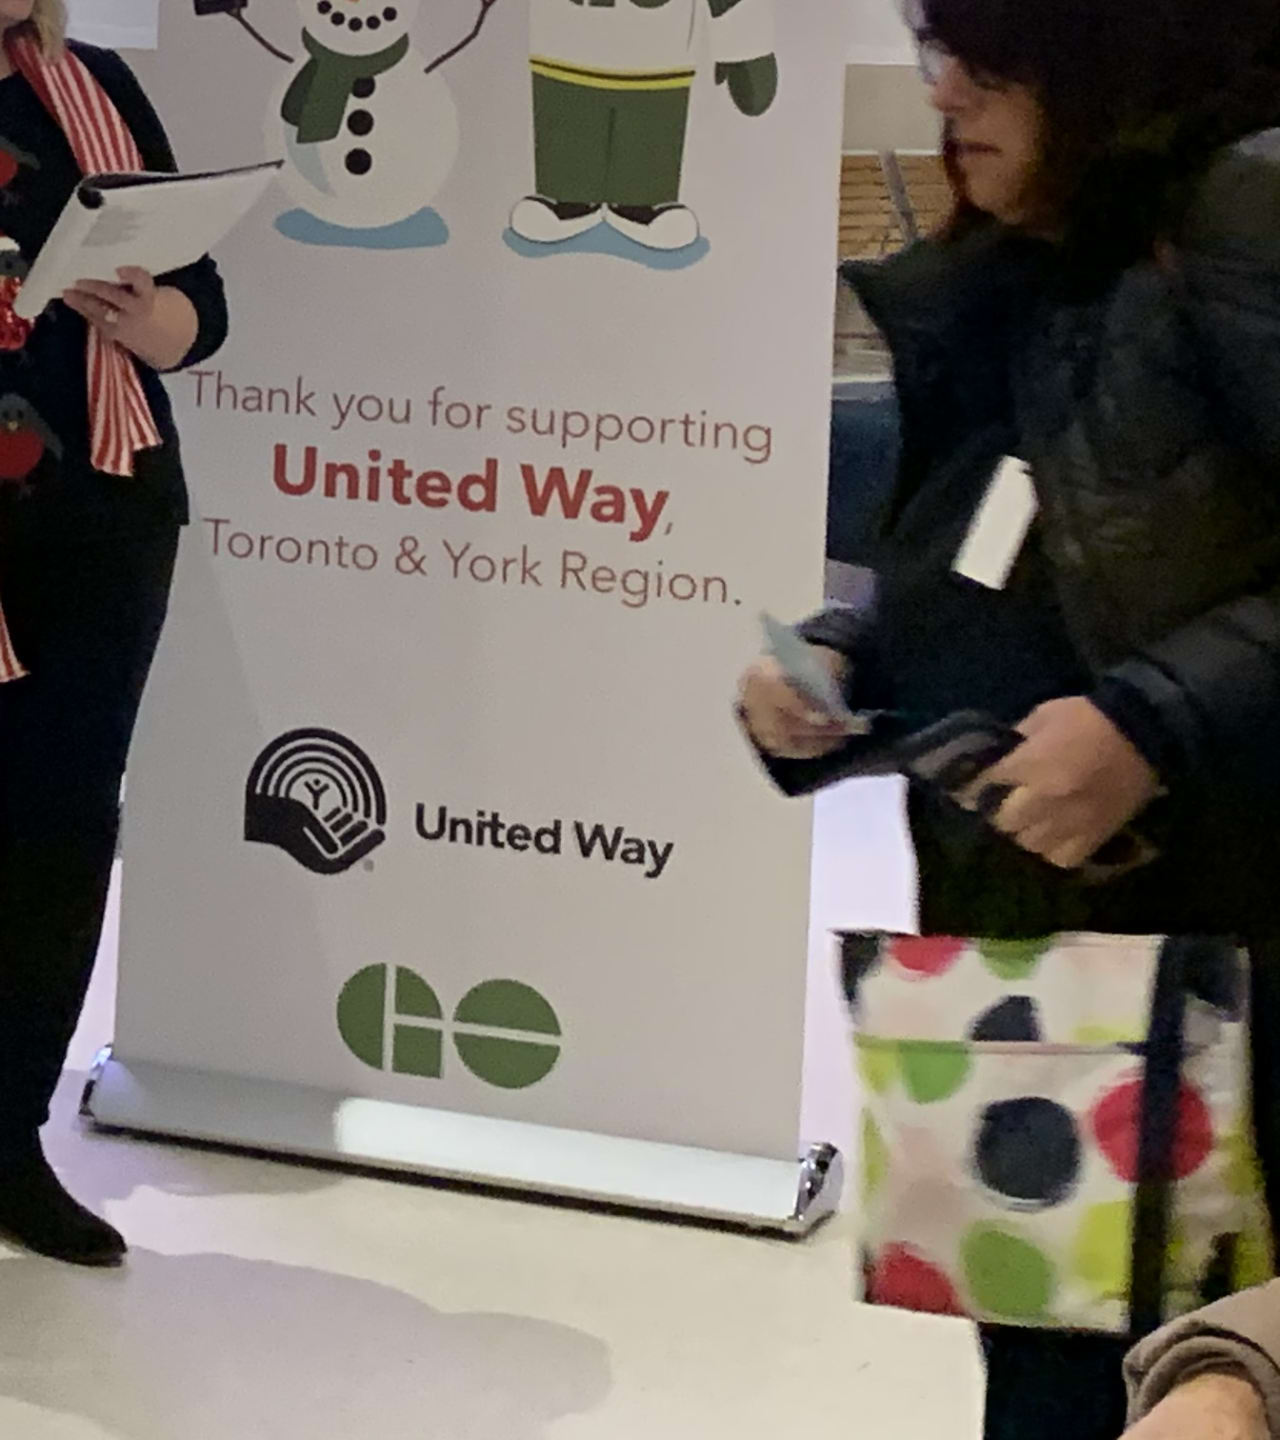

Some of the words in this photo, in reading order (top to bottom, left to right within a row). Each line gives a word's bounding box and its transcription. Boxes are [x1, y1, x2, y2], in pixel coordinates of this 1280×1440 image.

[188, 370, 317, 417] Thank
[331, 392, 411, 431] you
[427, 385, 493, 431] for
[506, 406, 773, 465] supporting
[273, 443, 499, 513] United
[520, 463, 674, 544] Way,
[202, 517, 379, 571] Toronto
[394, 535, 428, 577] &
[442, 539, 543, 587] York
[560, 549, 743, 609] Region.
[415, 802, 562, 856] United
[573, 820, 675, 880] Way
[337, 962, 562, 1089] GO
